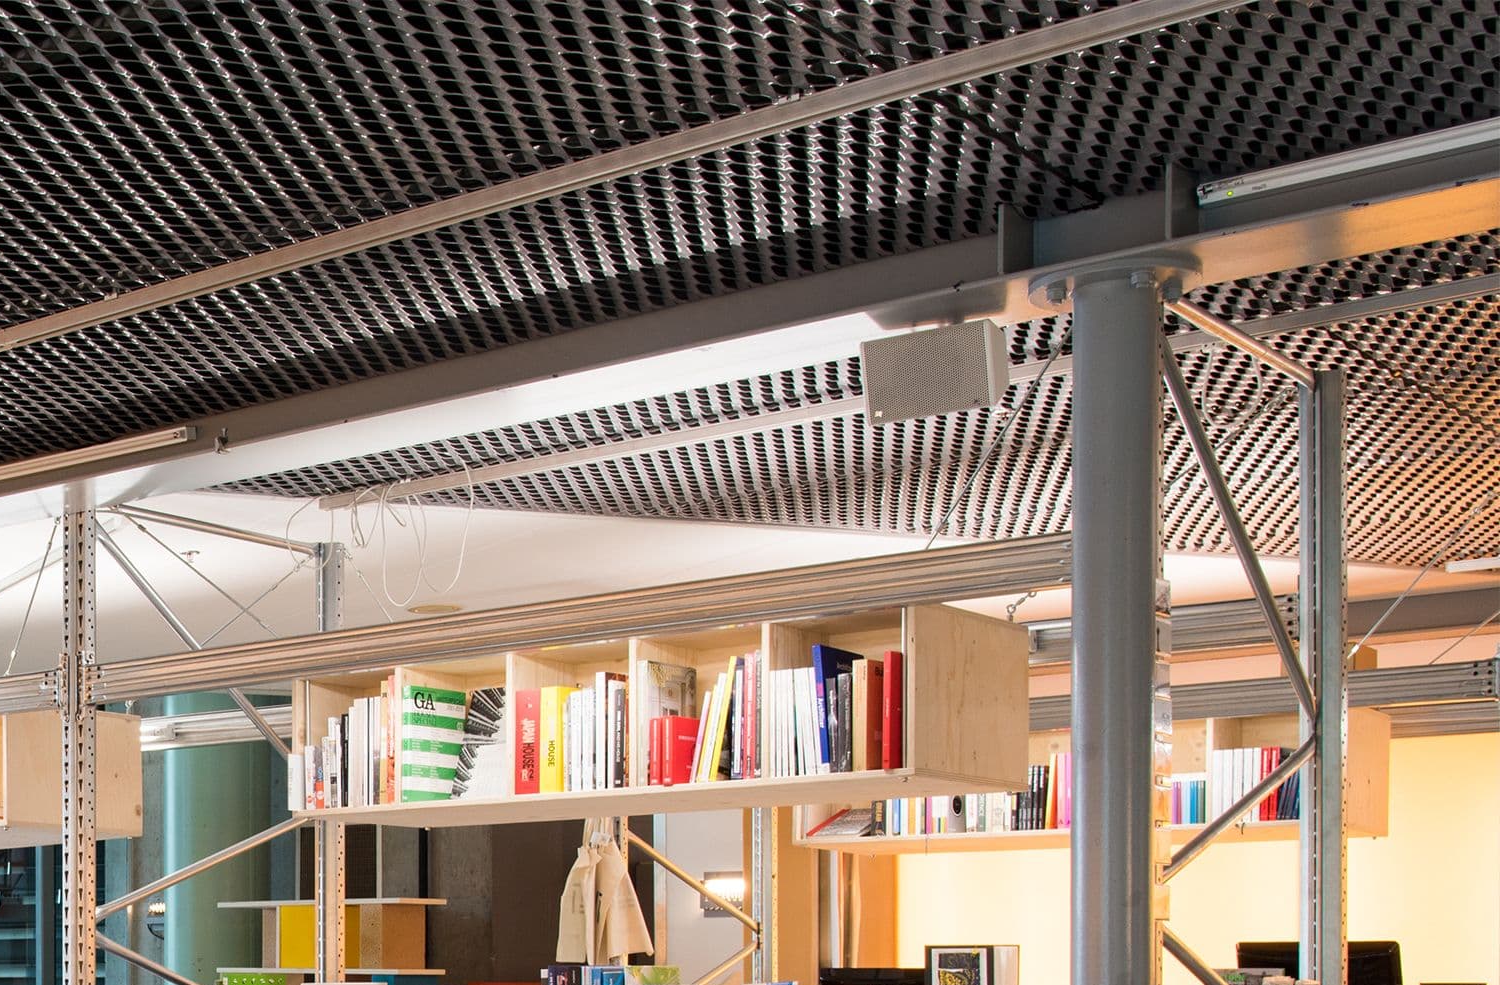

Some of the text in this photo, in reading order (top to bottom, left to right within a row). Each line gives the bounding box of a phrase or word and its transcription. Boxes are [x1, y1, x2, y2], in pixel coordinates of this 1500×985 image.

[413, 691, 436, 711] GA
[521, 719, 536, 769] JAPAN HOUSE
[547, 740, 556, 768] HOUSE
